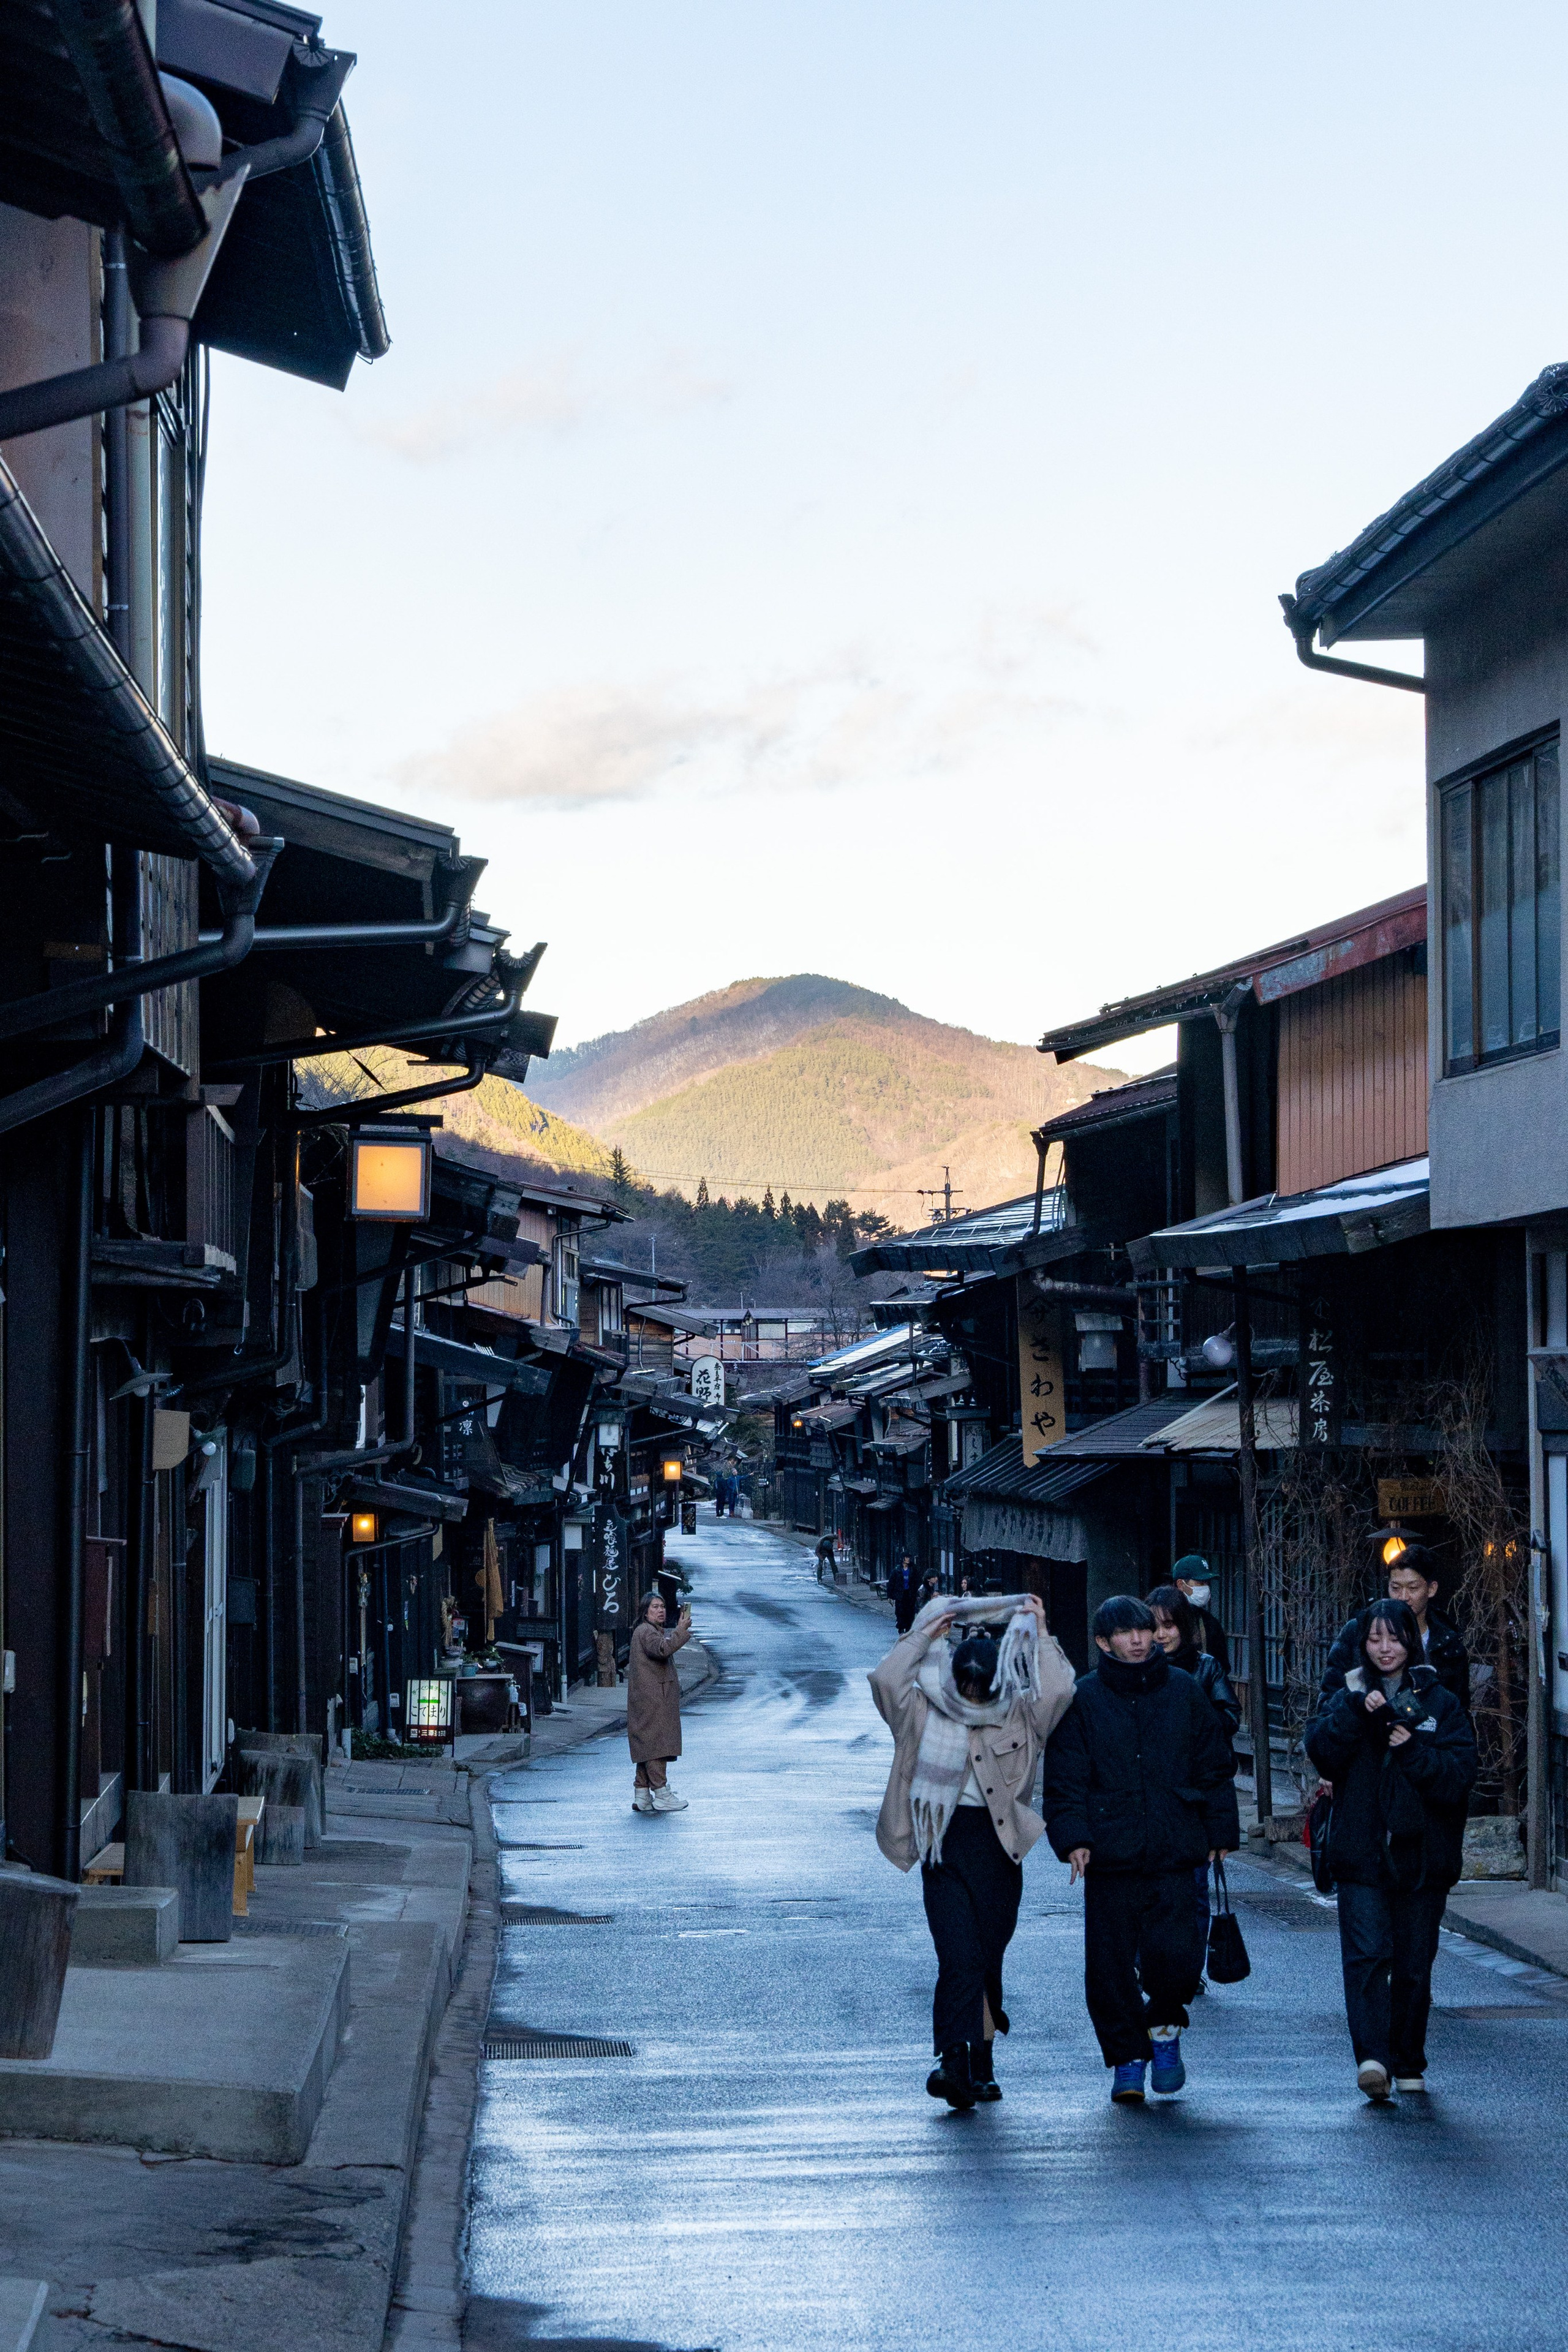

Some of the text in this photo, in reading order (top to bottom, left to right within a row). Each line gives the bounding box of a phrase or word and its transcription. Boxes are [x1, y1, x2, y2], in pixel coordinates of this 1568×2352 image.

[696, 1369, 711, 1400] 花野
[1308, 1328, 1334, 1442] 松屋茶房
[411, 1705, 446, 1719] こでまり
